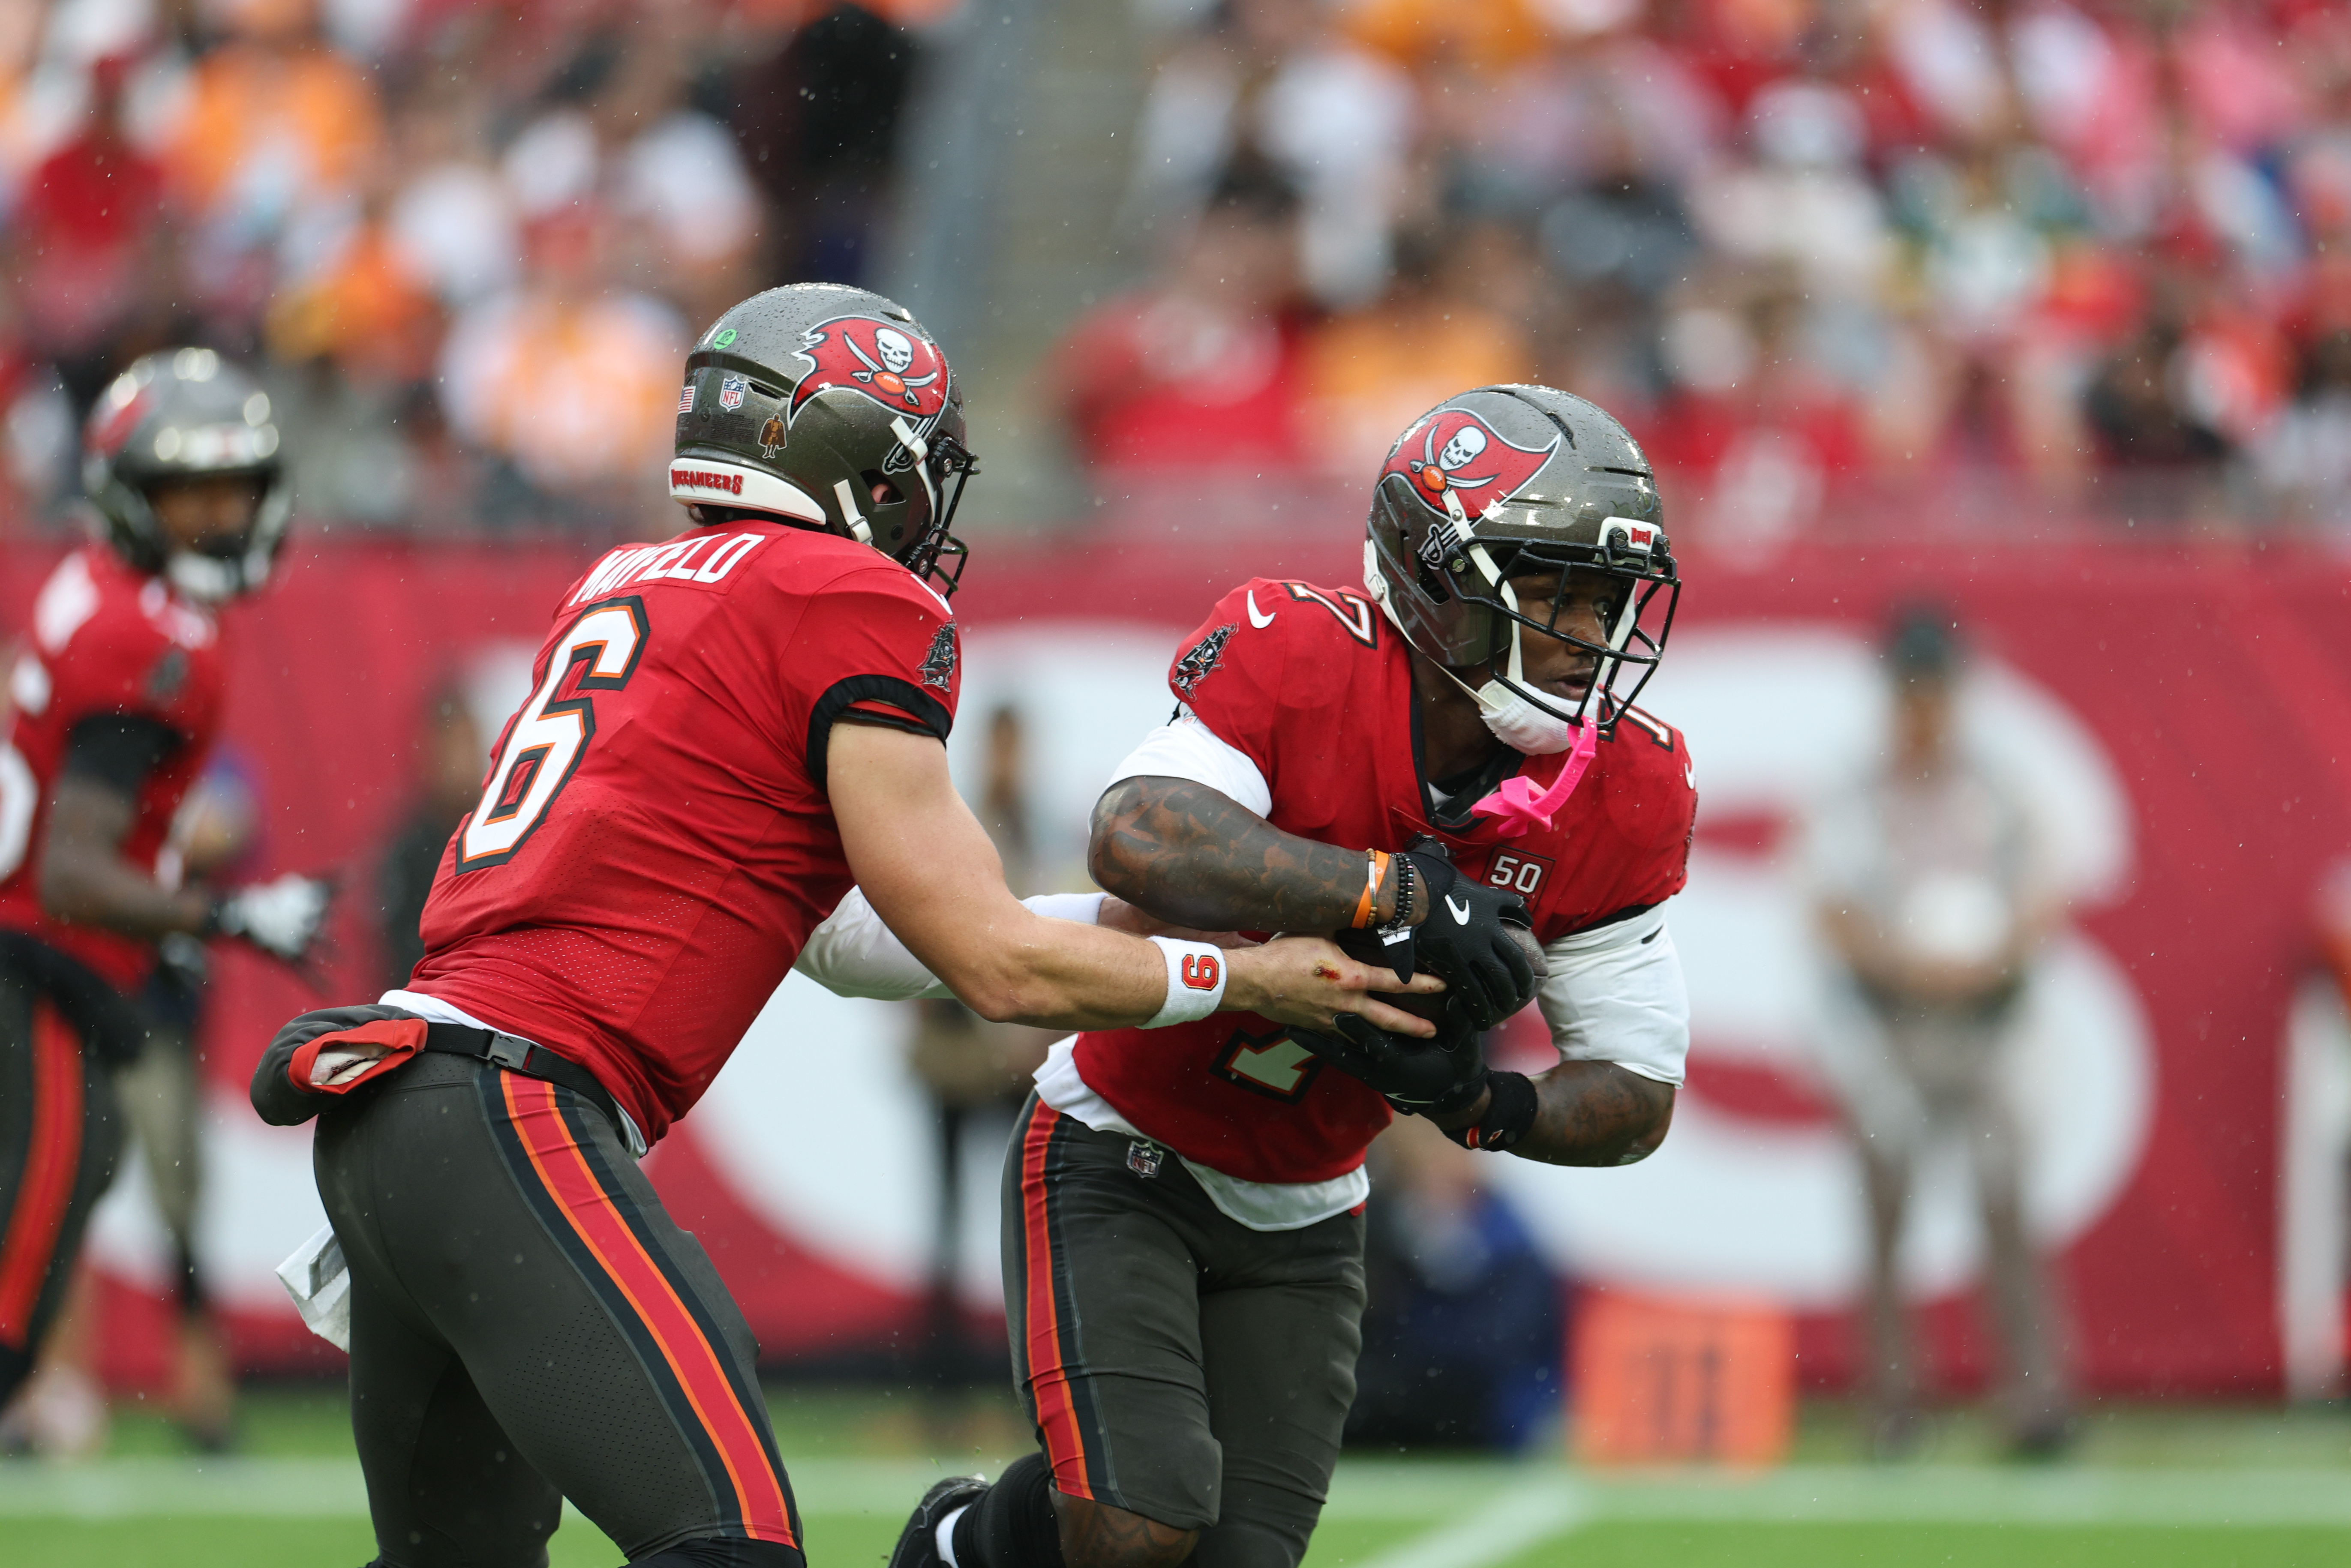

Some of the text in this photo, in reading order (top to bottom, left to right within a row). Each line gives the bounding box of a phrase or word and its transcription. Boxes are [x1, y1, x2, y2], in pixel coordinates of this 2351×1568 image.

[722, 391, 739, 405] NFL
[455, 595, 651, 876] 6
[1490, 854, 1543, 894] 50
[1132, 1156, 1155, 1173] NFL
